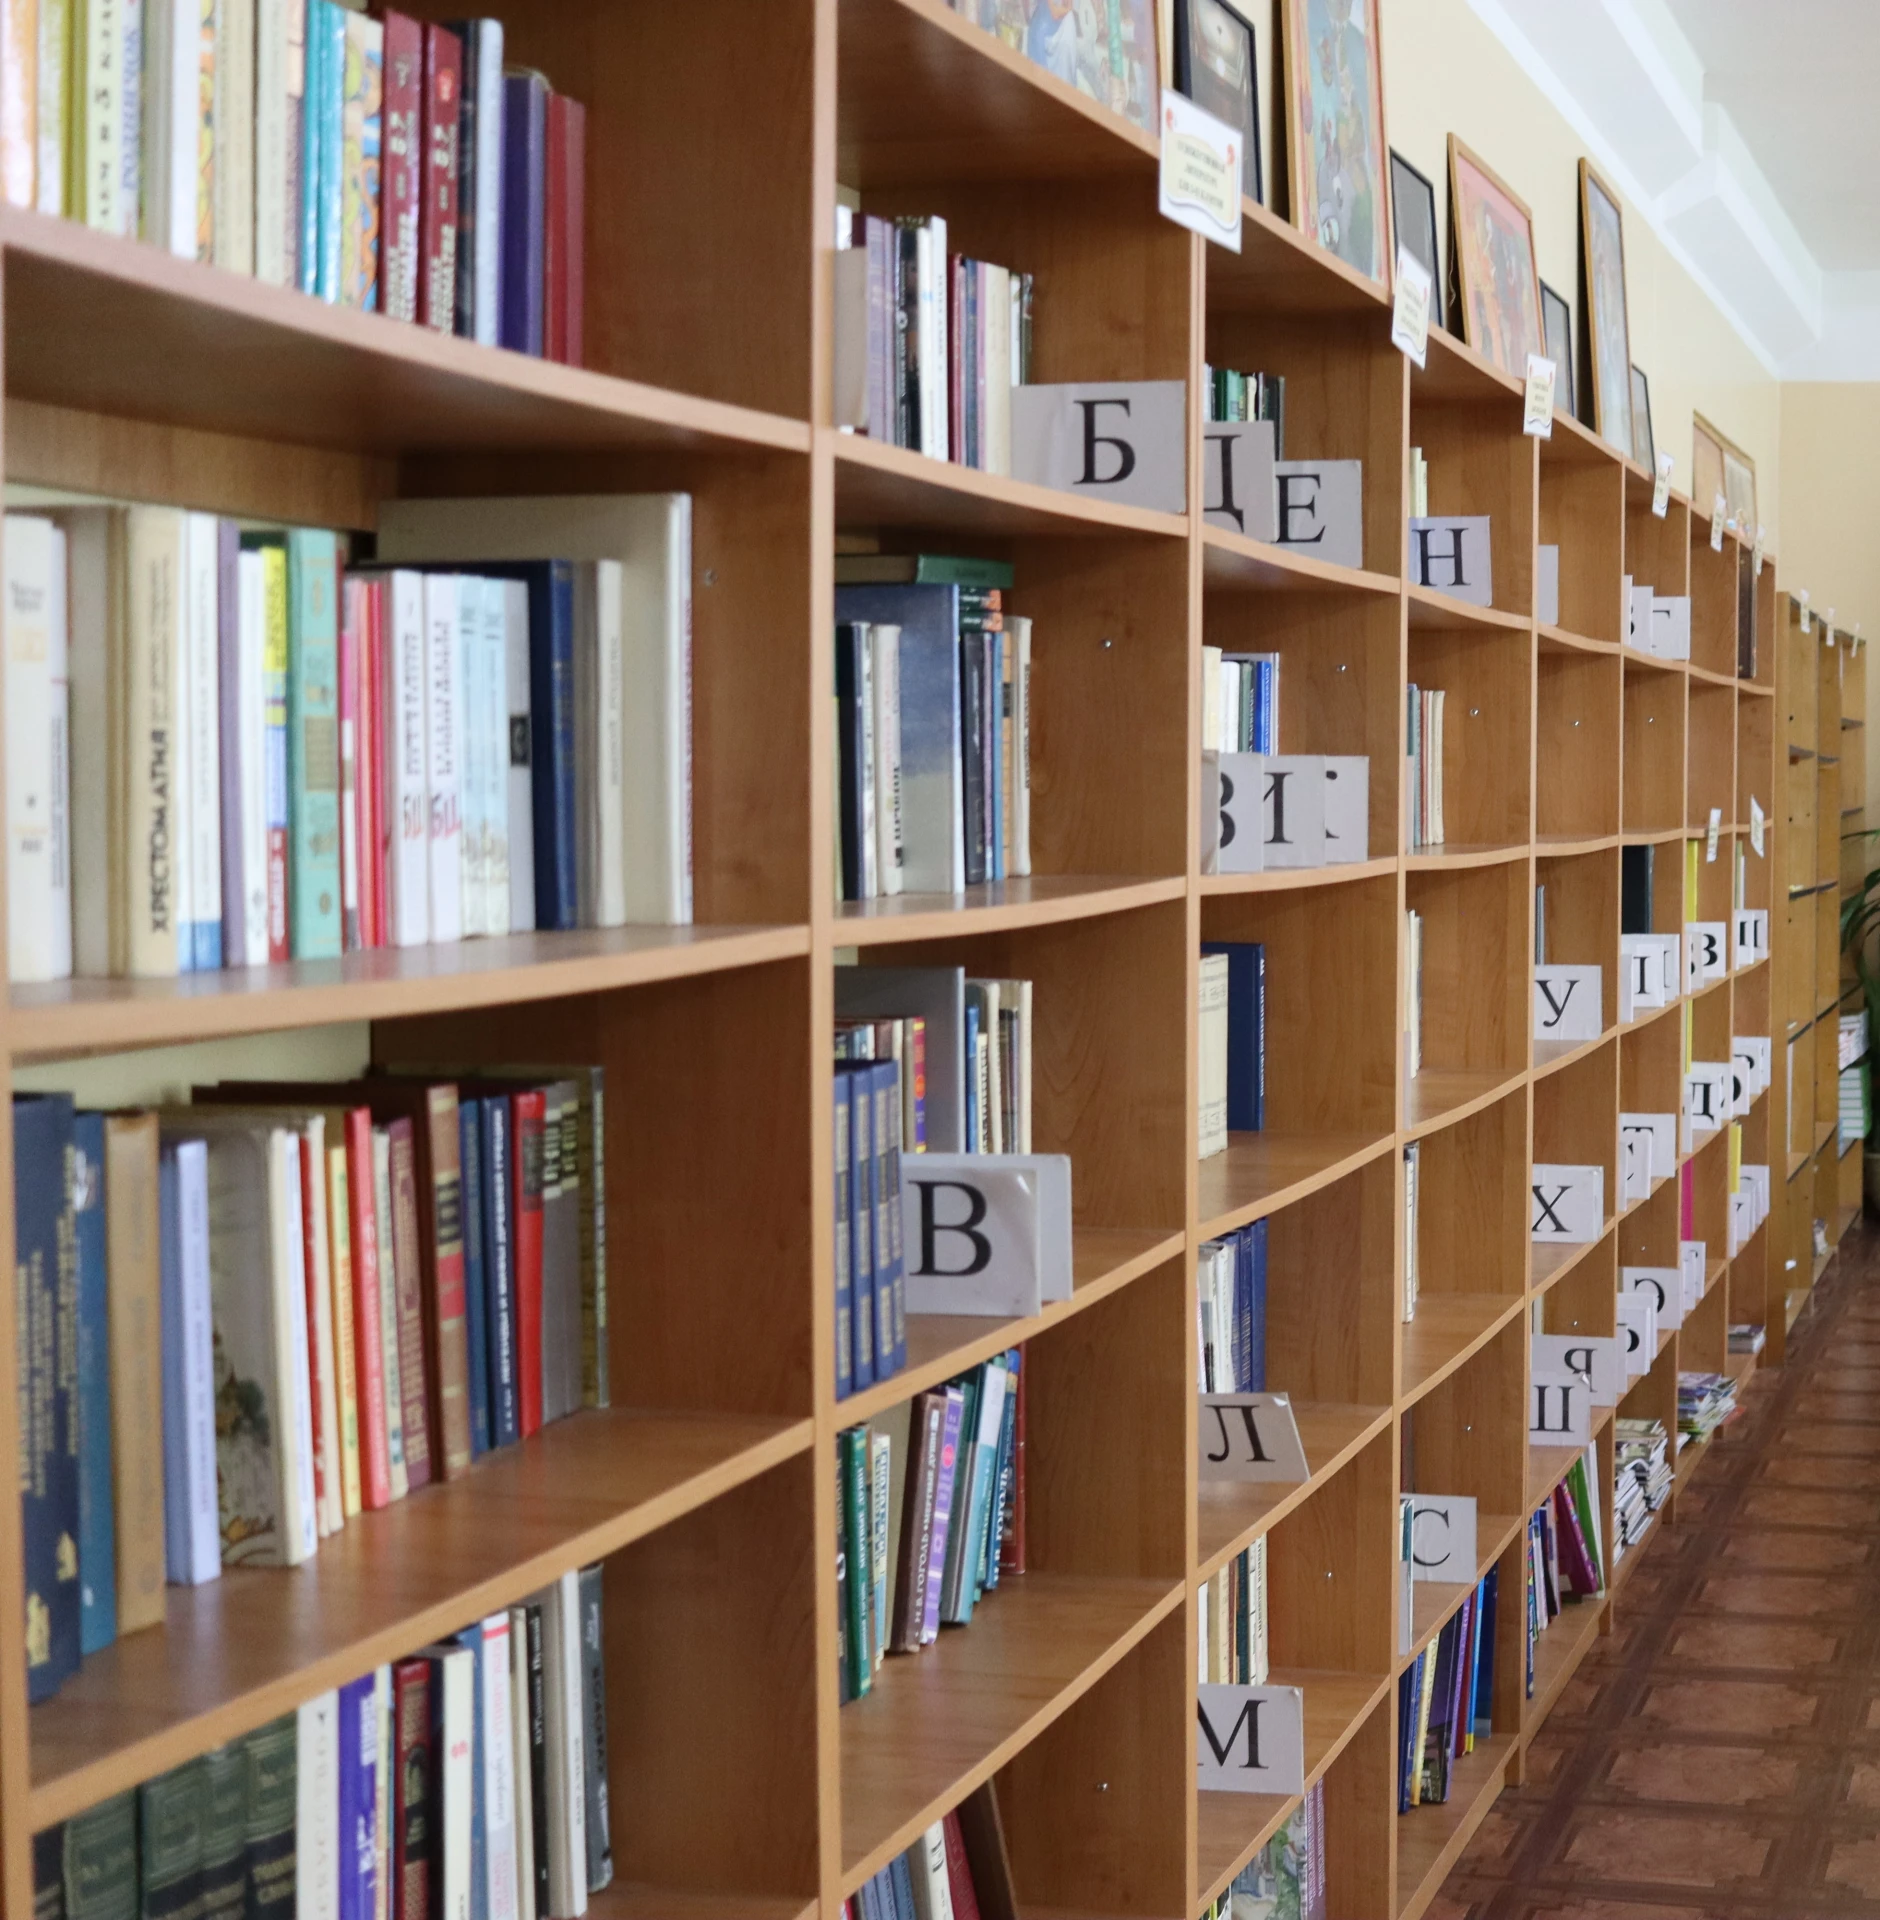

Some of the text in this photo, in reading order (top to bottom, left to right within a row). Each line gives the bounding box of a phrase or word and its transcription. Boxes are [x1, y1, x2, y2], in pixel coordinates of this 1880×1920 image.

[1072, 399, 1136, 485] Б
[1271, 473, 1327, 545] Е
[1411, 527, 1472, 587] Н
[149, 728, 170, 934] ХРЕСТОМАТИЯ
[1534, 979, 1581, 1028] У
[907, 1179, 993, 1277] В
[1532, 1185, 1573, 1232] Х
[1564, 1348, 1598, 1393] Я
[1205, 1404, 1276, 1463] Л
[1412, 1508, 1452, 1567] С
[1197, 1699, 1269, 1769] М
